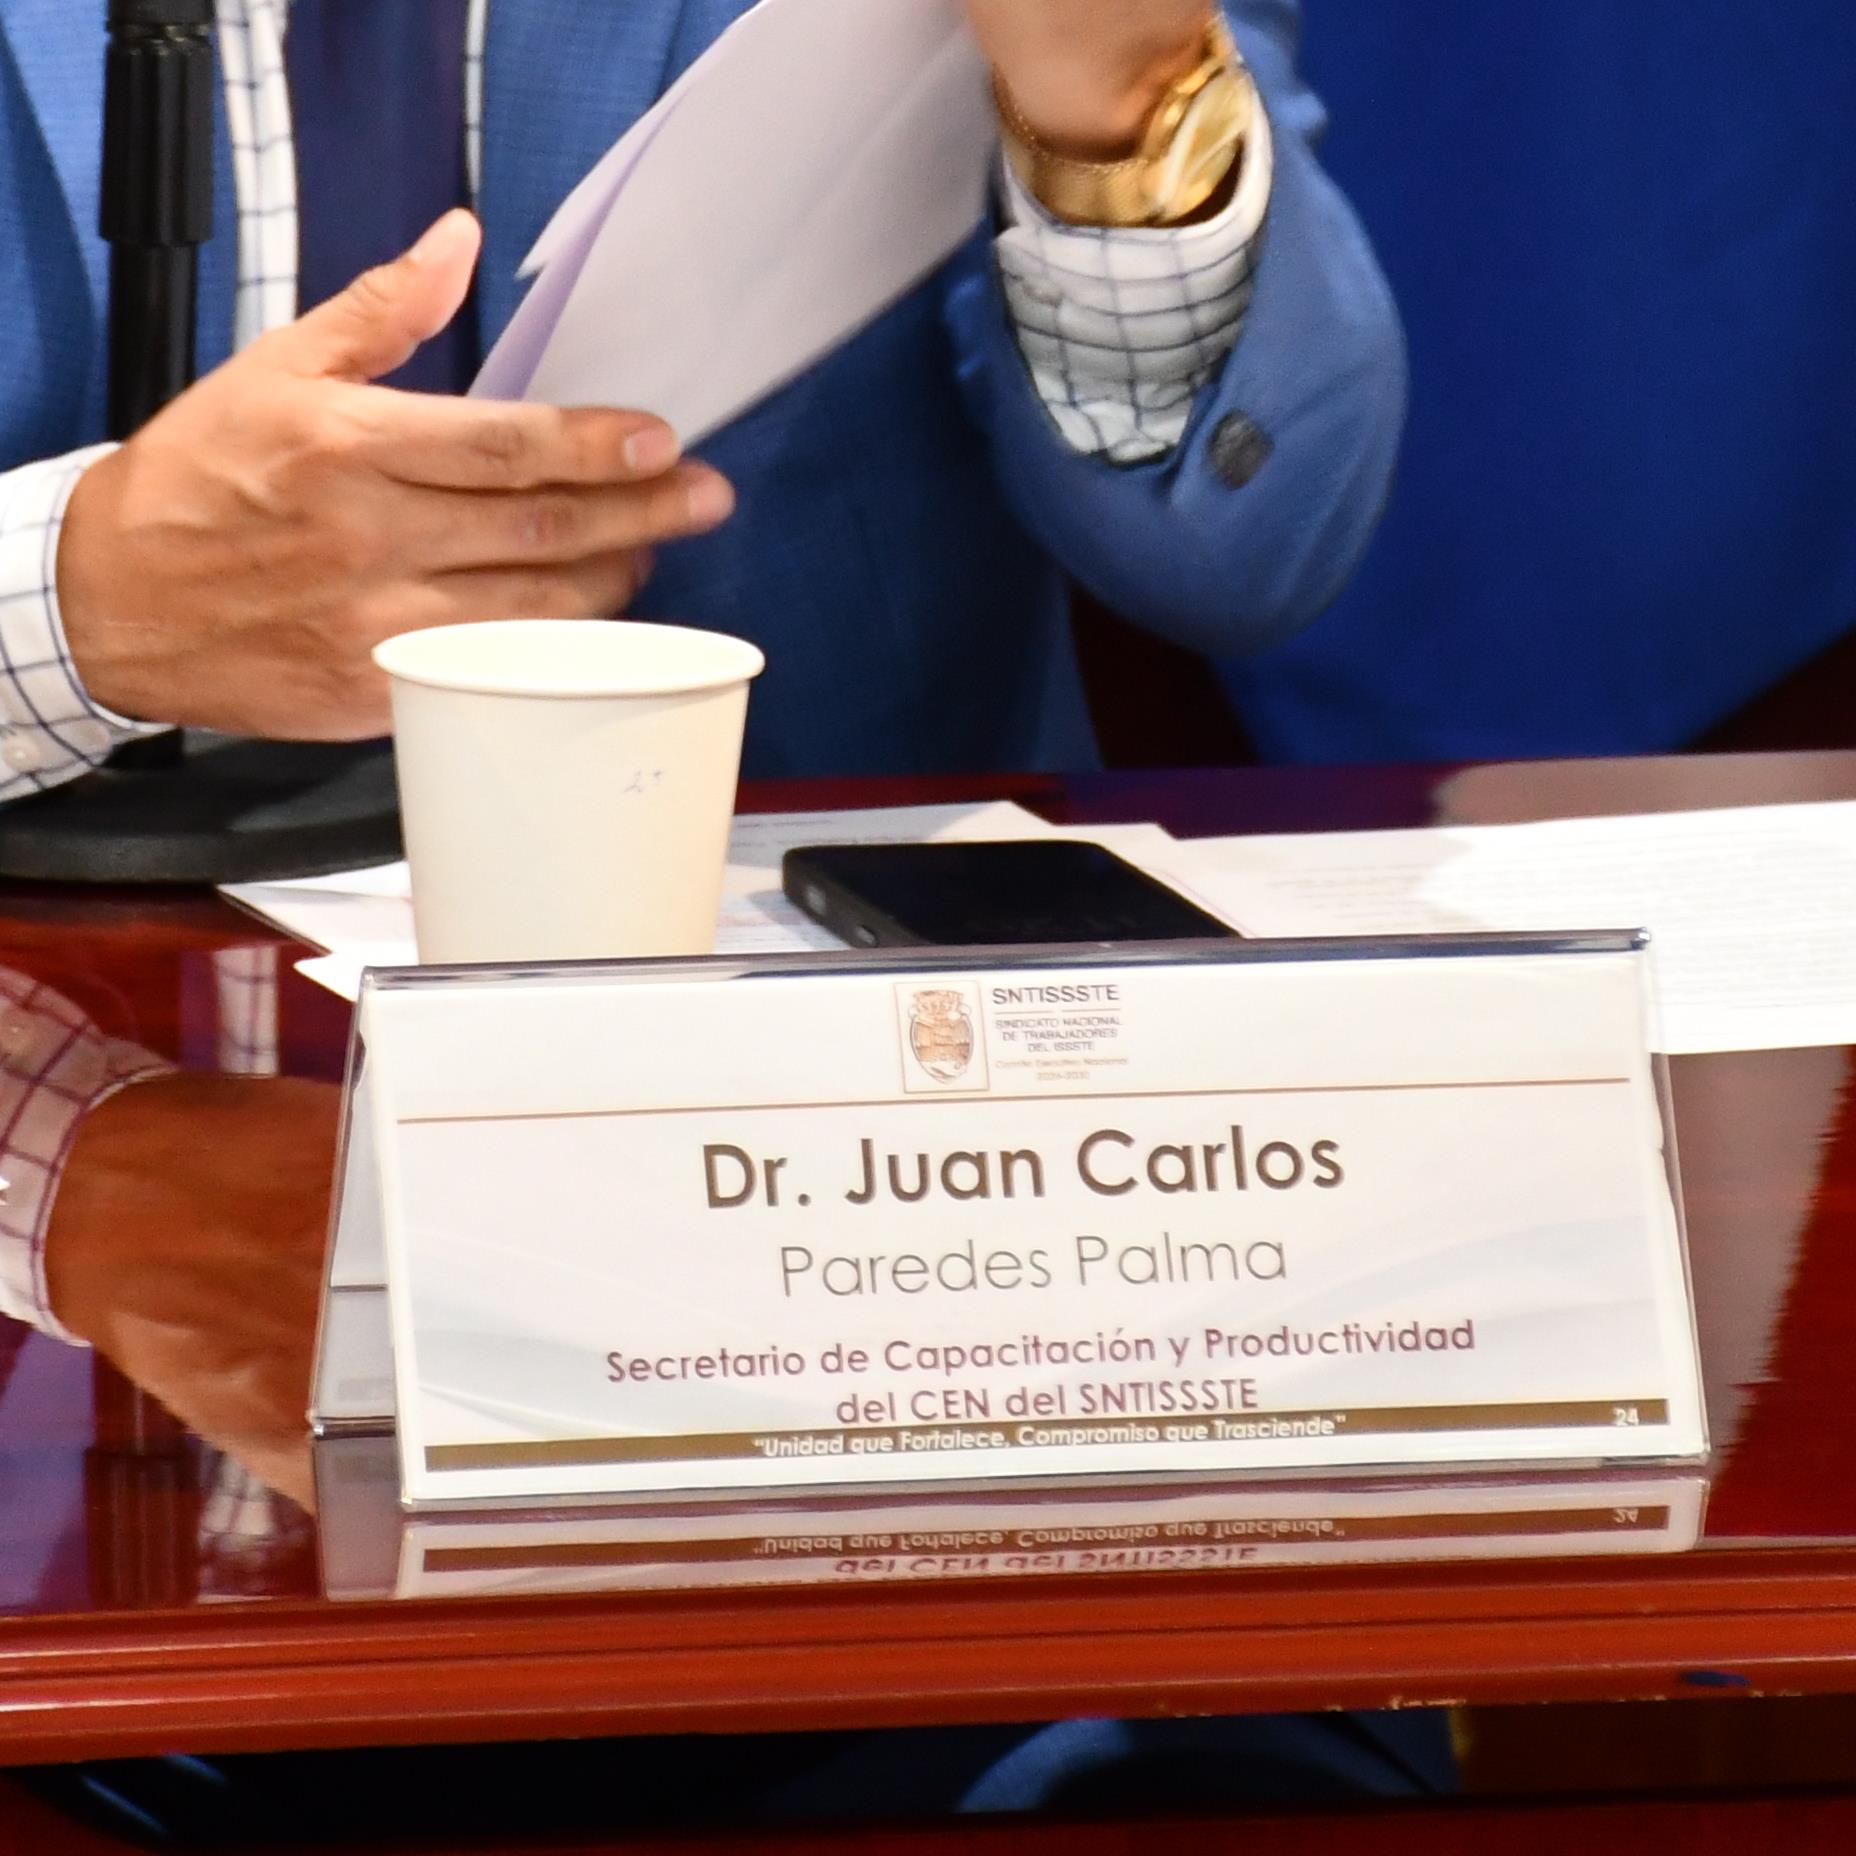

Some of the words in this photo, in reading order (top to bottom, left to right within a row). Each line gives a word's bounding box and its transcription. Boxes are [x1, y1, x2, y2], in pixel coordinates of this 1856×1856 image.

[992, 984, 1121, 1005] SNTISSSTE
[994, 1017, 1060, 1029] SINDICATO
[1062, 1016, 1122, 1027] NACIONAL
[1002, 1030, 1017, 1041] DE
[1023, 1028, 1119, 1040] TRABAJADORES
[1027, 1042, 1049, 1053] DEL
[1053, 1040, 1095, 1052] ISSSTE
[703, 1142, 812, 1209] Dr.
[844, 1137, 1046, 1206] Juan
[1077, 1124, 1346, 1196] Carlos
[780, 1238, 1053, 1298] Paredes
[1075, 1231, 1288, 1286] Palma
[606, 1345, 807, 1383] Secretario
[820, 1342, 870, 1375] de
[884, 1328, 1156, 1377] Capacitación
[1168, 1335, 1190, 1369] y
[1205, 1319, 1477, 1358] Productividad
[835, 1390, 897, 1424] del
[910, 1388, 991, 1422] CEN
[1005, 1384, 1067, 1417] del
[1080, 1378, 1259, 1415] SNTISSSTE
[1611, 1406, 1640, 1427] 24
[850, 1435, 894, 1456] que
[899, 1429, 1011, 1452] Fortalece,
[1018, 1422, 1160, 1448] Compromiso
[1163, 1423, 1209, 1446] que
